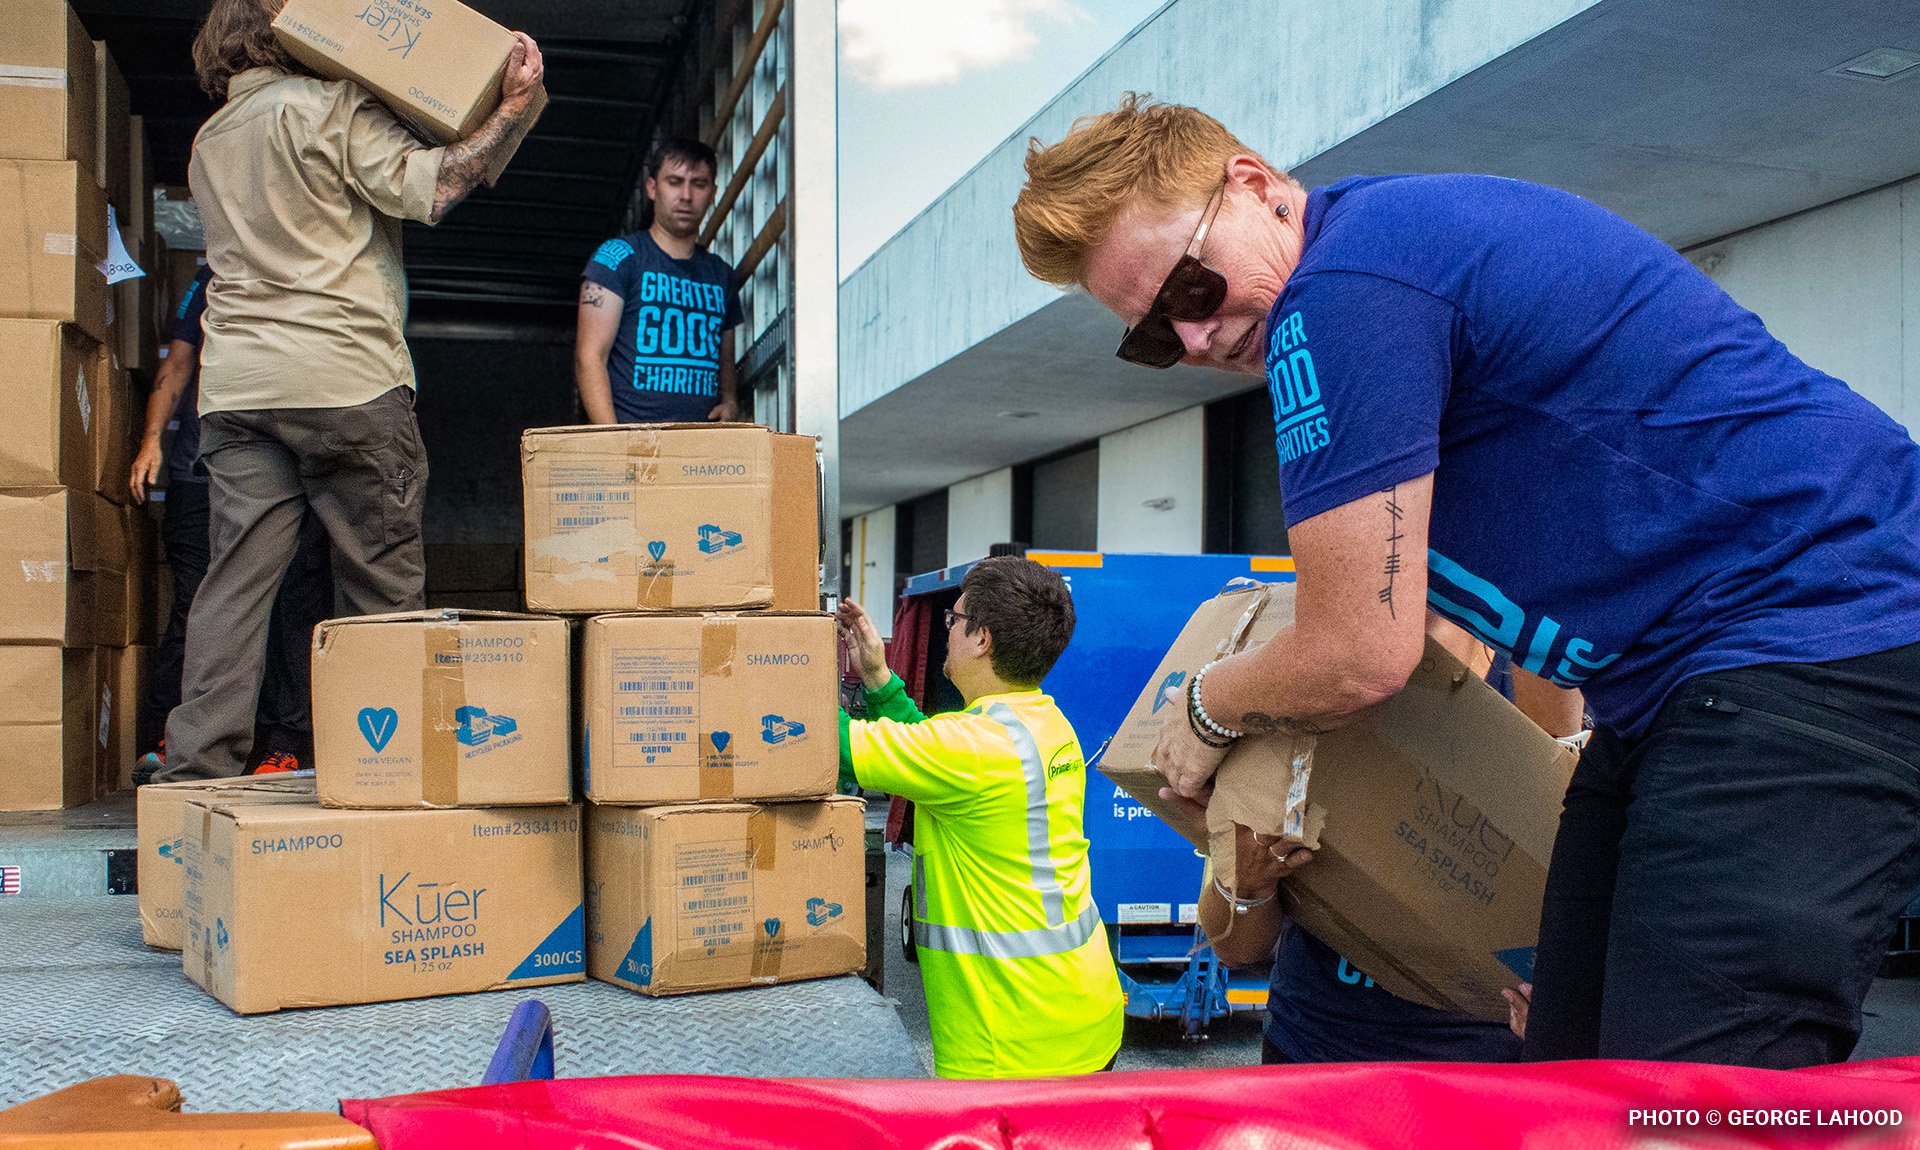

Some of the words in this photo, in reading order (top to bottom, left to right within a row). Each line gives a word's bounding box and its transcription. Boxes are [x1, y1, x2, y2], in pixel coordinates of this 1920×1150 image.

[414, 4, 433, 20] SEA
[408, 86, 458, 120] SHAMPOO
[640, 271, 726, 315] GREATER
[632, 364, 719, 397] CHARITIE
[682, 464, 746, 477] SHAMPOO
[457, 637, 524, 648] SHAMPOO
[746, 653, 810, 666] SHAMPOO
[641, 746, 672, 754] CARTON
[646, 755, 656, 764] OF
[1113, 803, 1125, 818] is
[1127, 805, 1156, 821] pre
[472, 819, 578, 838] Item#2334110
[251, 834, 343, 854] SHAMPOO
[1395, 820, 1429, 856] SEA
[1429, 848, 1497, 905] SPLASH
[391, 923, 477, 944] SHAMPOO
[384, 949, 416, 965] SEA
[420, 942, 485, 961] SPLASH
[534, 949, 583, 969] 300/CS
